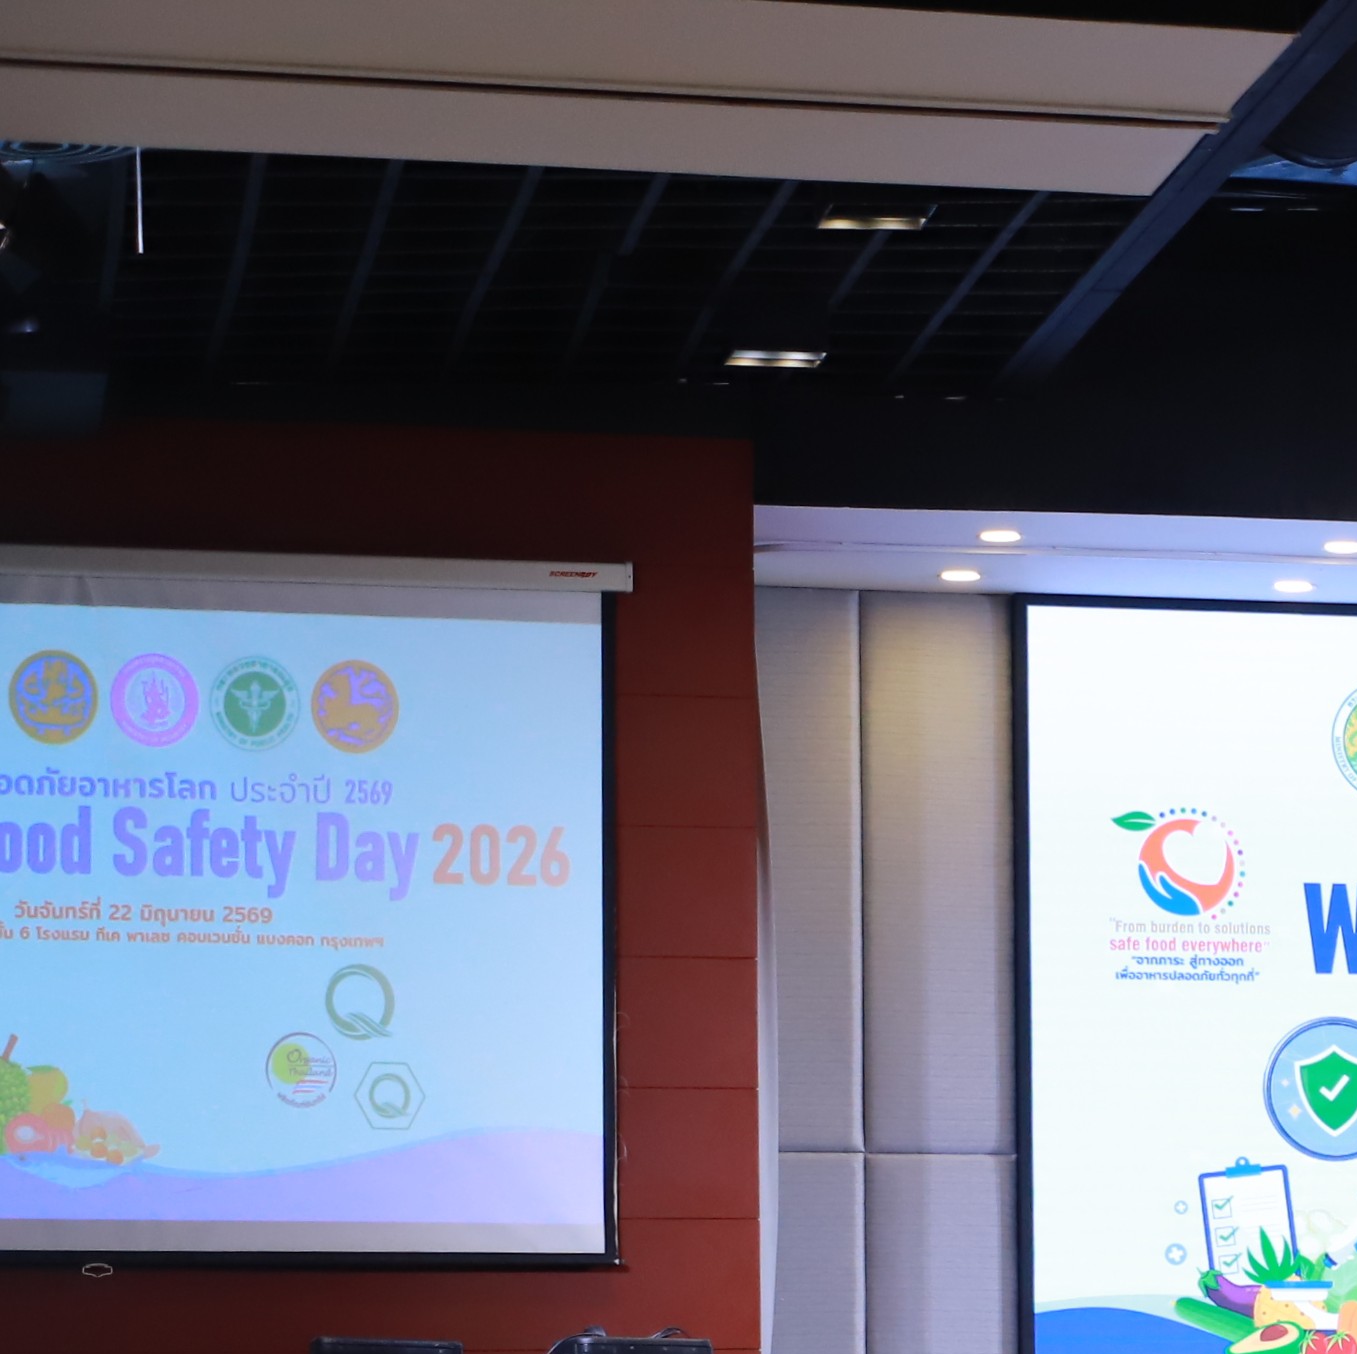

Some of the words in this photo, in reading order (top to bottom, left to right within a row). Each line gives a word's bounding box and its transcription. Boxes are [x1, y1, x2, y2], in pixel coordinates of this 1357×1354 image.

[230, 774, 332, 804] ประจำปี
[344, 779, 393, 806] 2569
[0, 806, 92, 875] ood
[112, 806, 297, 899] Safety
[315, 811, 420, 900] Day
[432, 823, 571, 888] 2026
[15, 897, 102, 920] วันจันทร์ที่
[109, 904, 132, 921] 22
[140, 904, 215, 927] มิถุนายน
[222, 906, 273, 923] 2569
[20, 926, 30, 940] 6
[36, 926, 90, 941] โรงแรม
[1151, 921, 1194, 933] burden
[1199, 922, 1211, 934] to
[1215, 922, 1271, 935] solutions
[1110, 937, 1140, 951] safe
[1146, 937, 1176, 951] food
